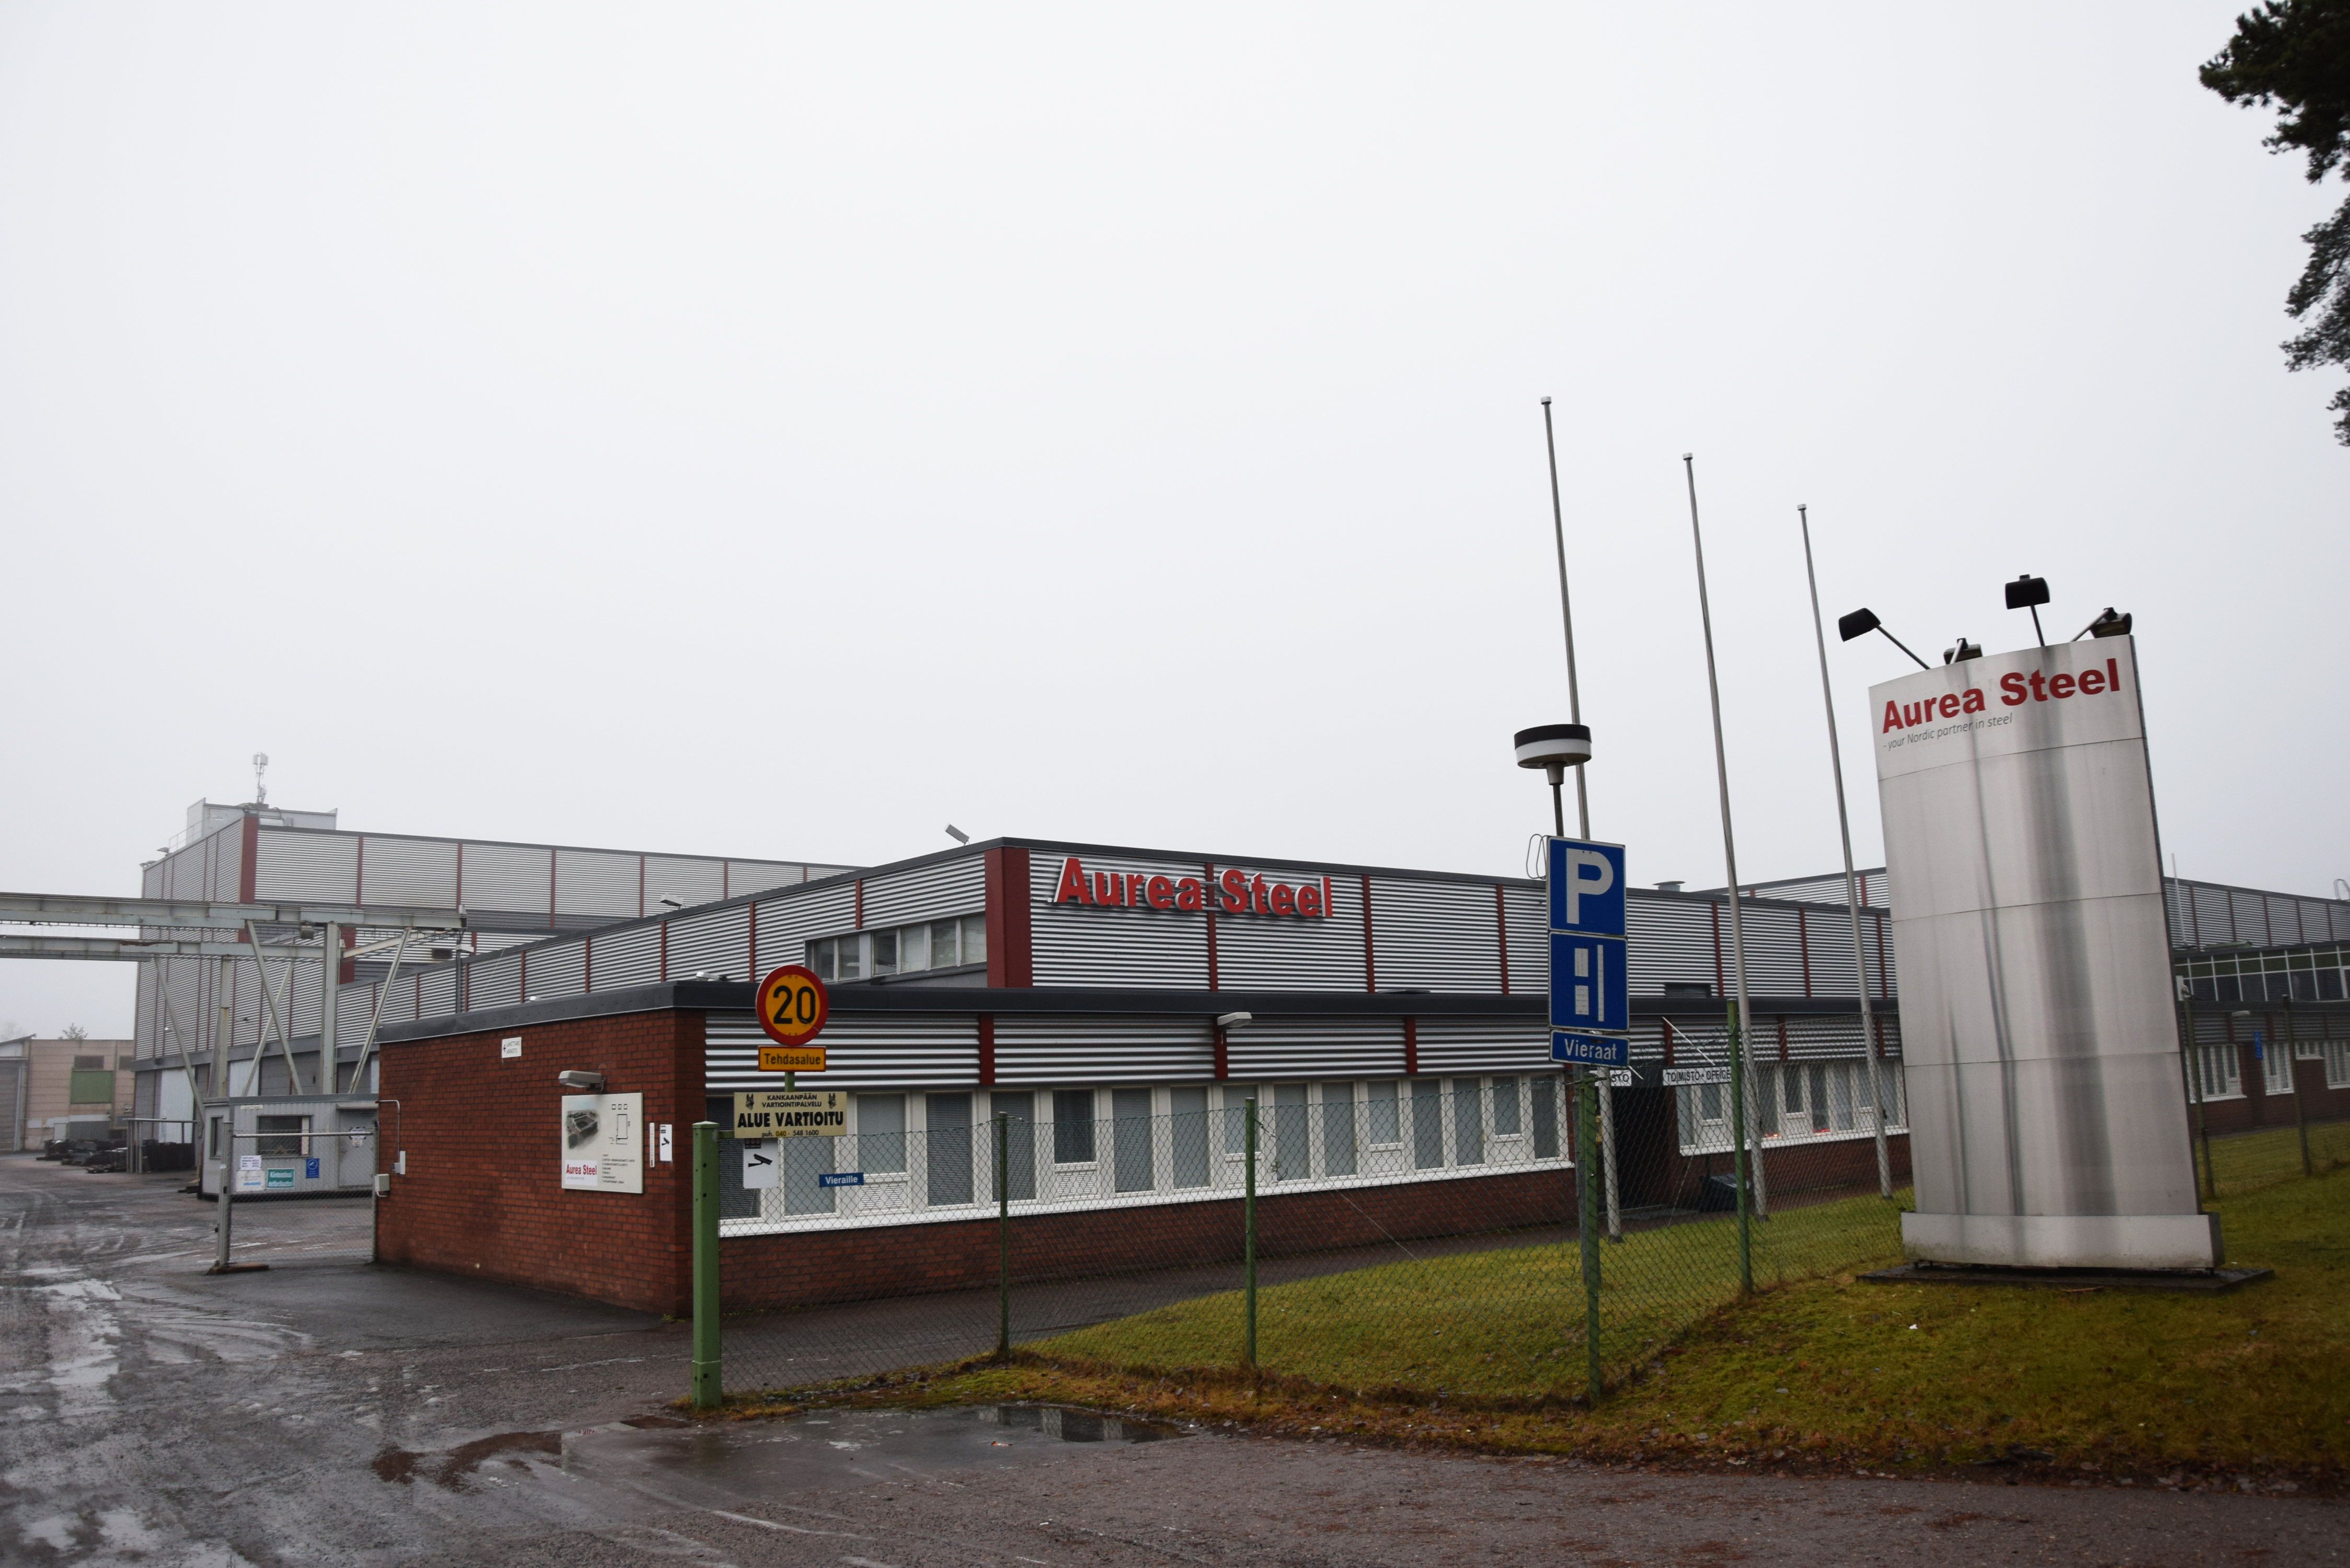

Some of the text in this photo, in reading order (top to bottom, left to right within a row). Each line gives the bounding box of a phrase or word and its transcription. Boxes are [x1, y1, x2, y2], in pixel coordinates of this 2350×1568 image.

[1883, 658, 2121, 734] Aurea Steel
[1888, 737, 1905, 751] your
[1907, 729, 1934, 744] Nordic
[1937, 722, 1973, 740] partner
[1976, 719, 1985, 730] in
[1988, 712, 2013, 728] steel
[1054, 857, 1333, 918] Aurea Steel
[1566, 848, 1614, 925] P
[773, 985, 816, 1024] 20
[764, 1053, 821, 1065] Tehdasalue
[1564, 1038, 1617, 1060] Vieraat
[1666, 1069, 1731, 1082] TOIMISTO OFFICE
[738, 1111, 844, 1127] ALUE VARTIOITU
[566, 1164, 597, 1175] Aurea Steel
[825, 1175, 858, 1184] Vieraille
